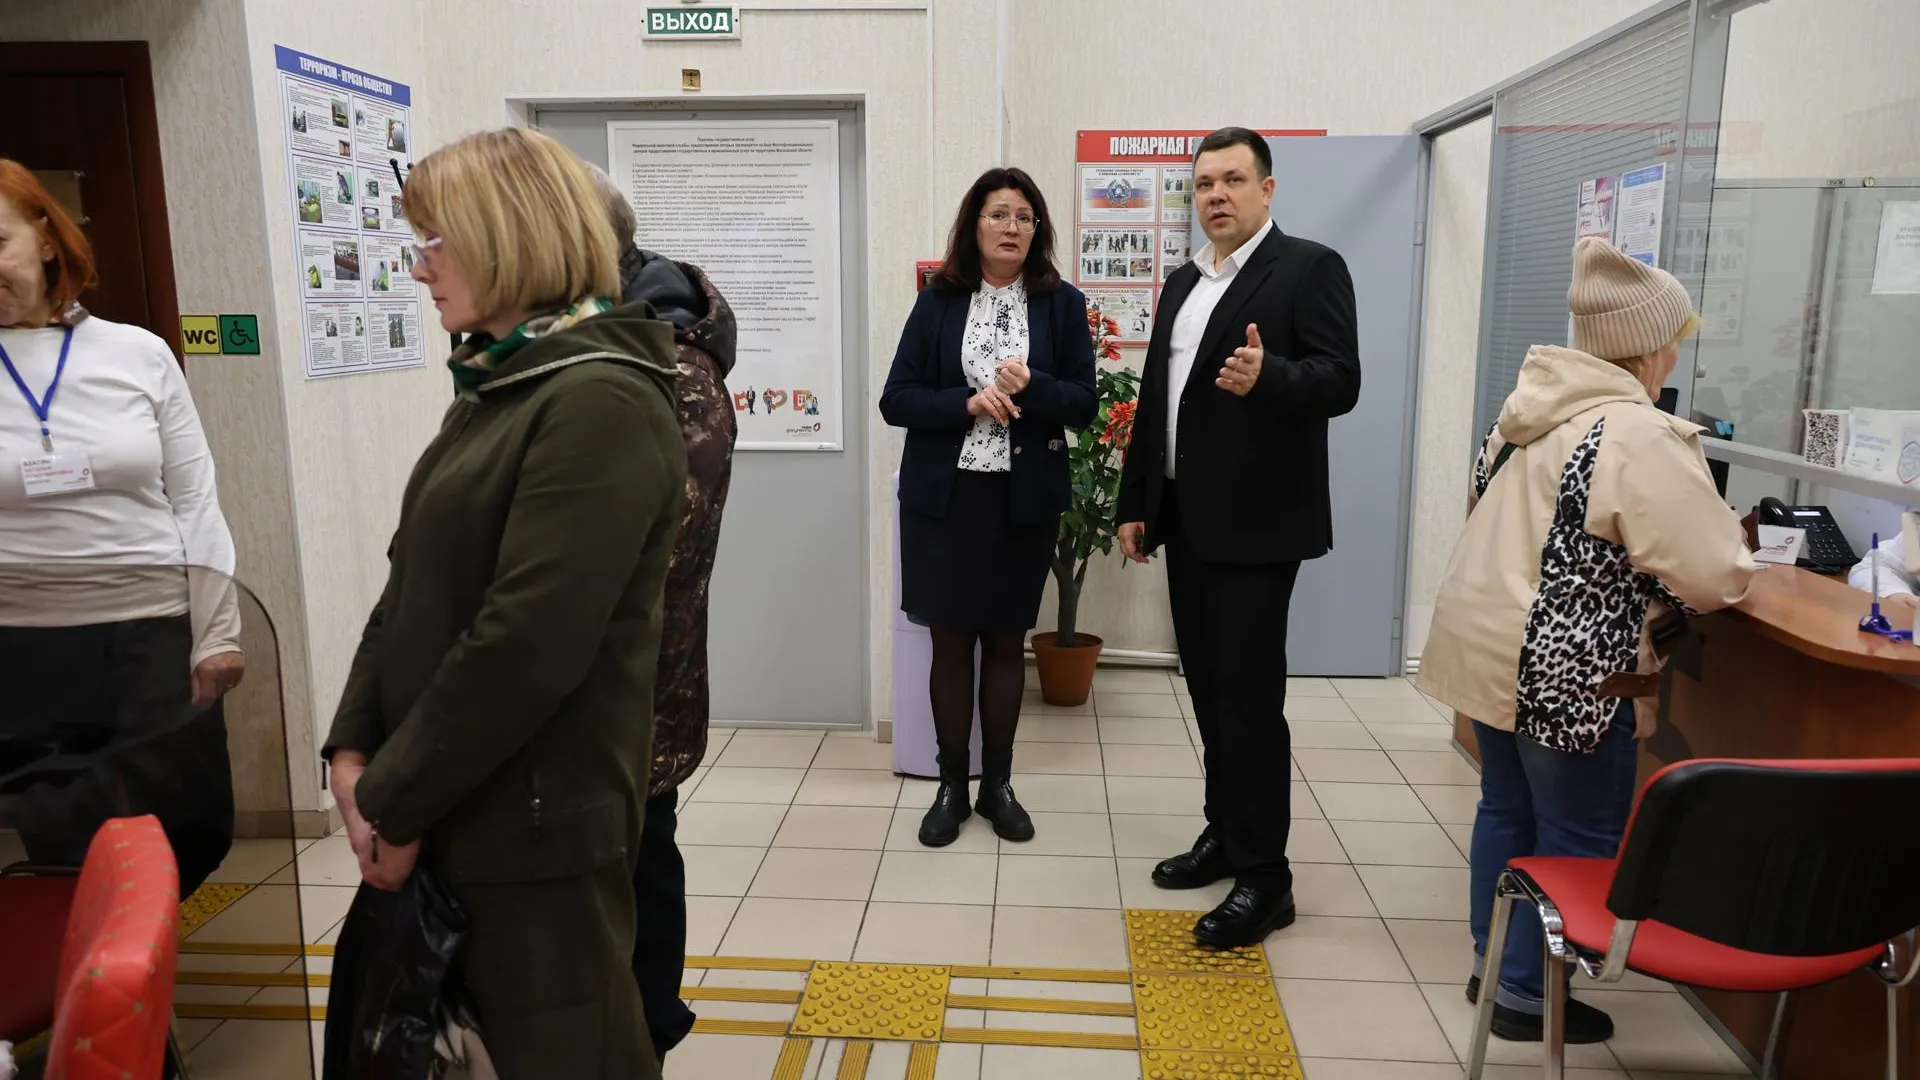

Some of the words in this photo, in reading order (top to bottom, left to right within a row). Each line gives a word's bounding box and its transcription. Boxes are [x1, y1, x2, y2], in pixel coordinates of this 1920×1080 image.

[651, 12, 730, 32] ВЫХОД
[298, 56, 338, 80] ТЕРРОРИЗМ
[341, 69, 363, 87] УГРОЗА
[363, 76, 393, 96] ОБЩЕСТВУ
[1109, 136, 1185, 155] ПОЖАРНАЯ
[183, 329, 217, 345] WC
